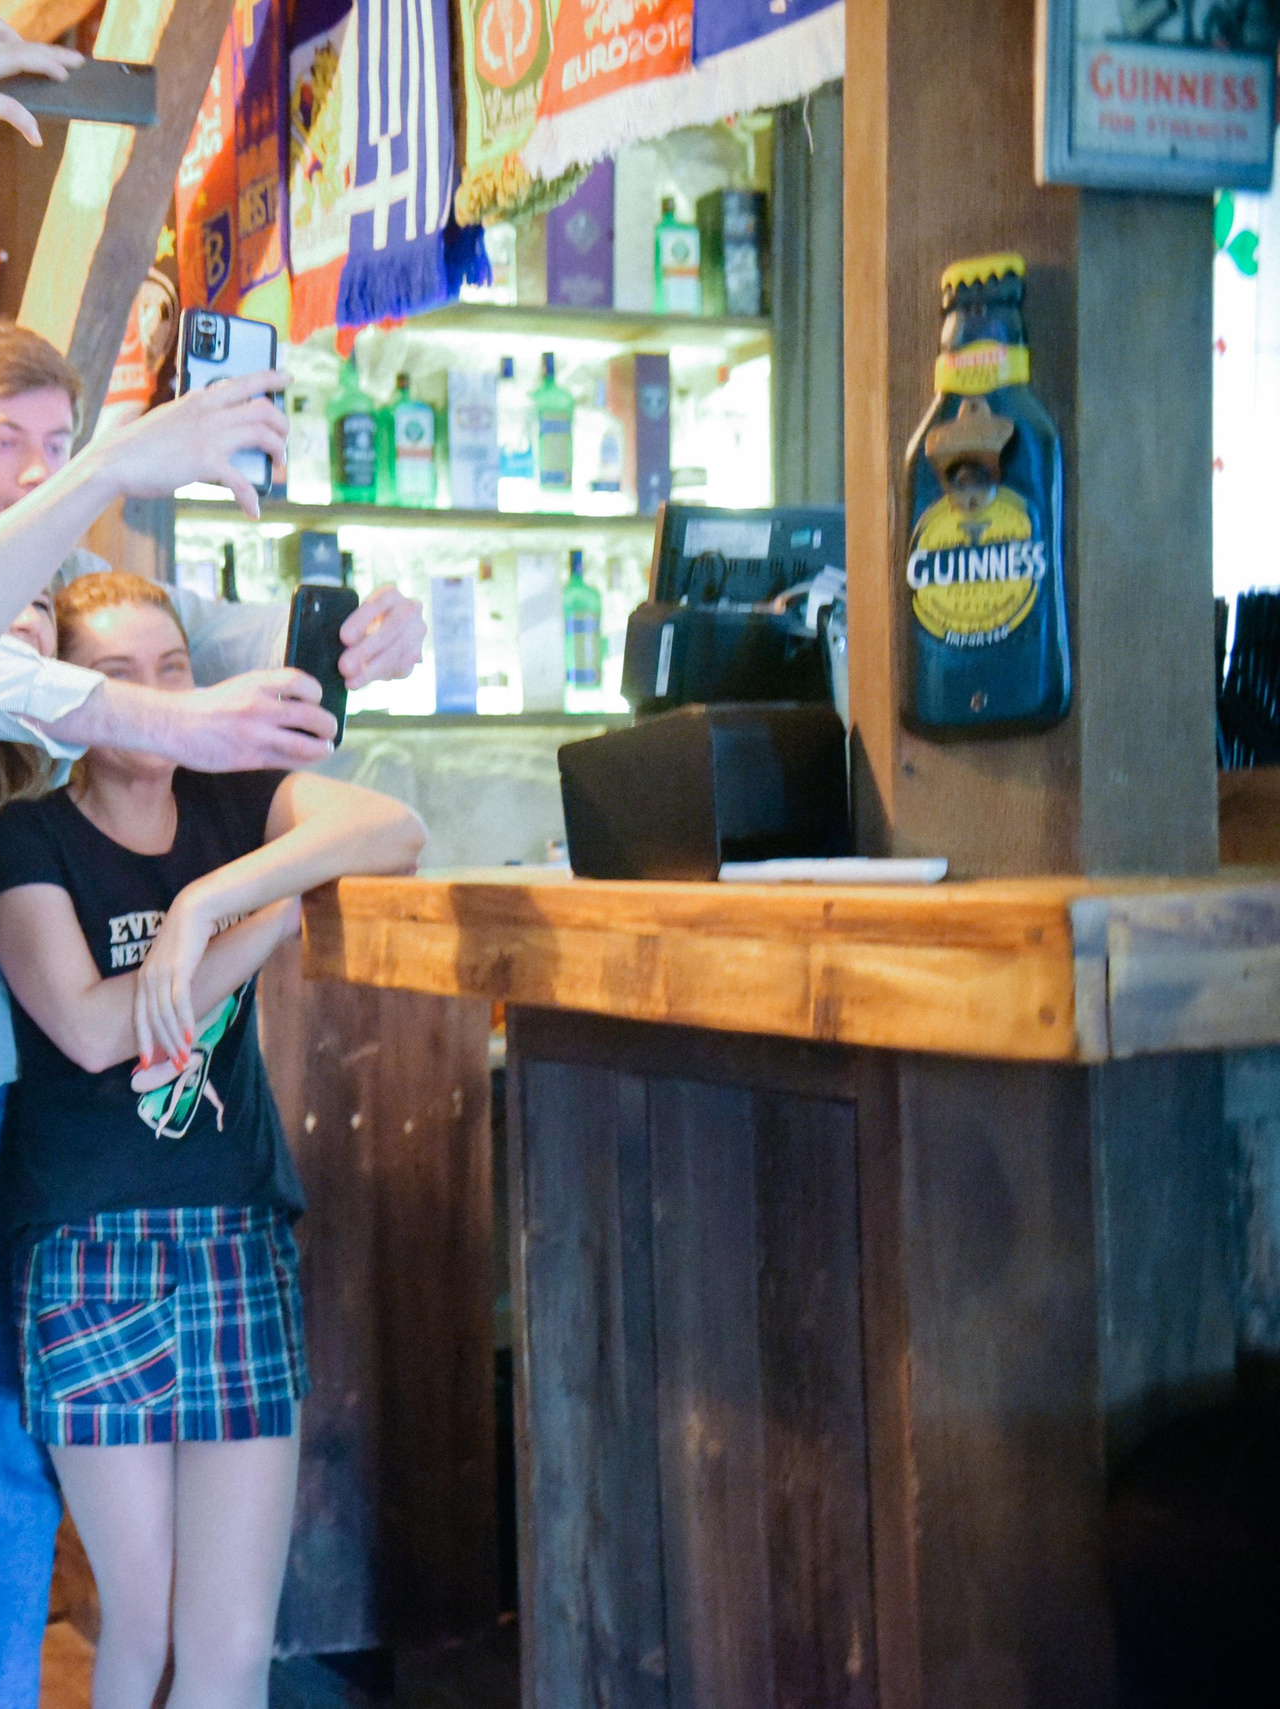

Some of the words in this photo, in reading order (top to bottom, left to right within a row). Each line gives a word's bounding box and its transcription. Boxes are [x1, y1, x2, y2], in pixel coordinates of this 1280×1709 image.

[561, 13, 692, 92] EURO2012
[1089, 52, 1258, 113] GUINNESS
[906, 538, 1047, 591] GUINNESS
[110, 943, 152, 968] NEE
